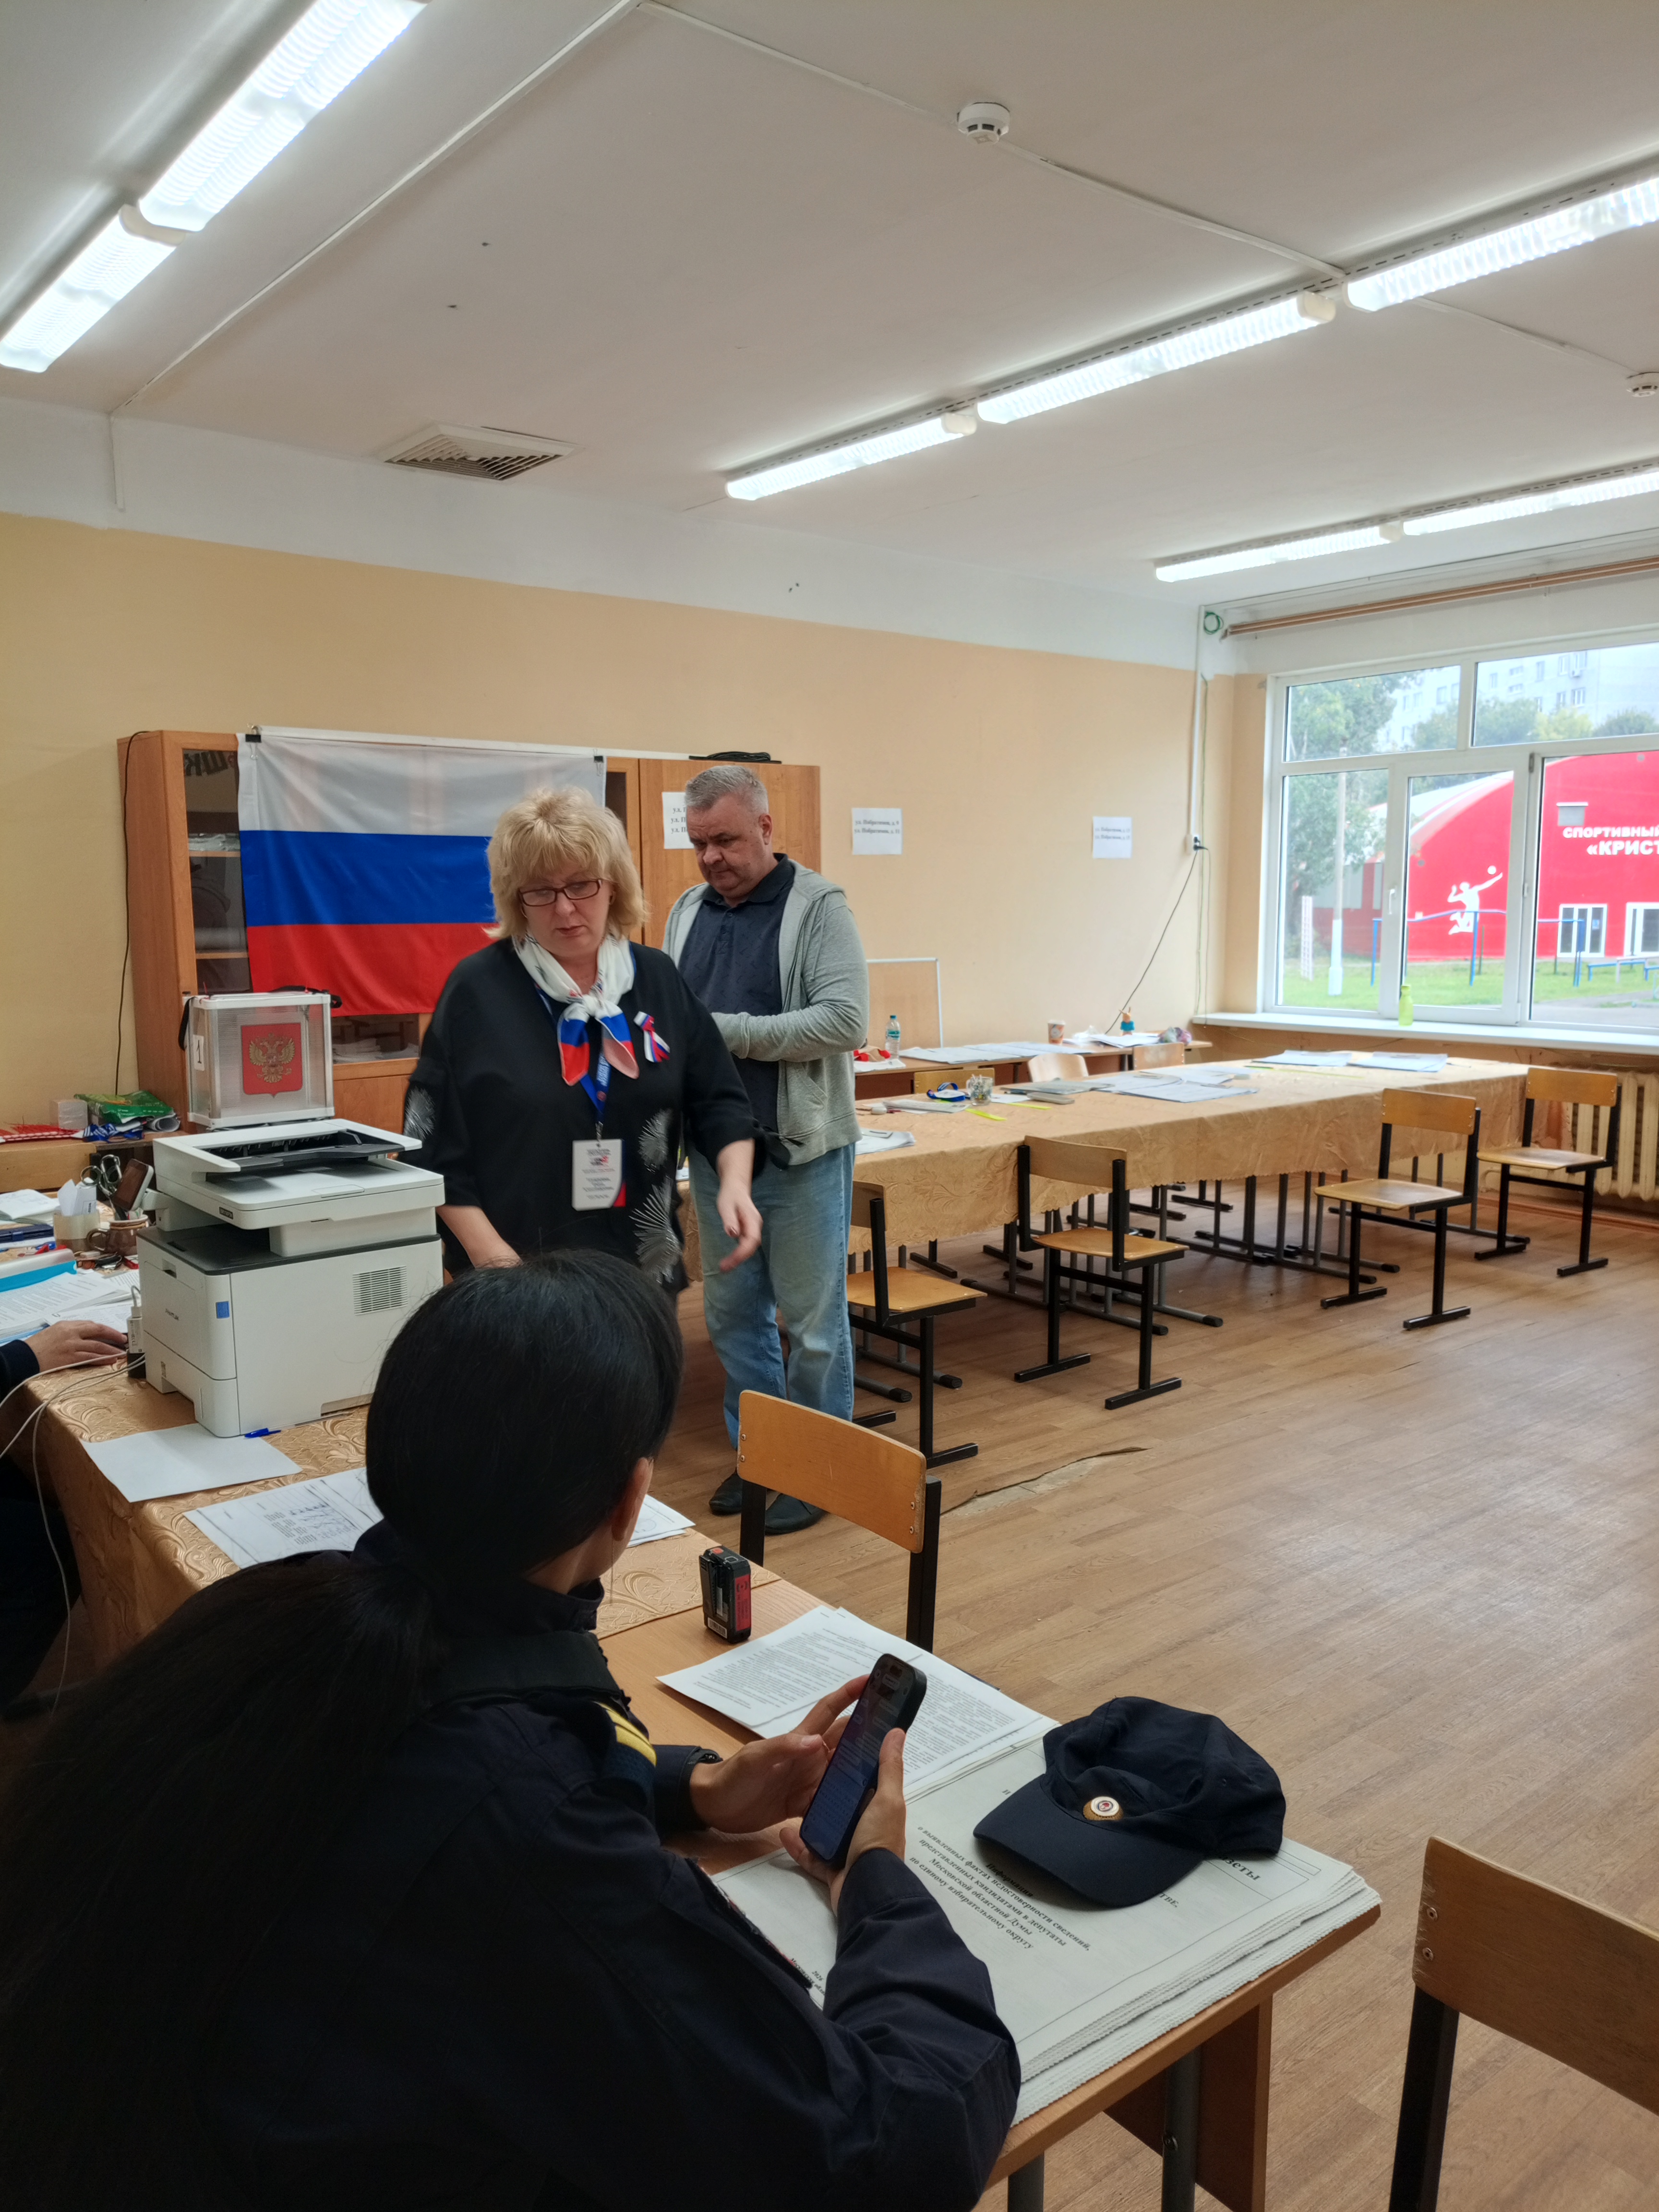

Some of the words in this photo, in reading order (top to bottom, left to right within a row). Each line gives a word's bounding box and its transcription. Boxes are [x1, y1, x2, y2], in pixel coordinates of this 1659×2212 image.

[196, 1040, 202, 1064] 1
[909, 1857, 920, 1865] по
[919, 1863, 949, 1887] единому
[948, 1886, 1007, 1929] избирательному
[1006, 1929, 1034, 1949] округу
[919, 1839, 975, 1881] представленных
[974, 1880, 1023, 1916] кандидатами
[1028, 1919, 1067, 1947] депутаты
[923, 1830, 966, 1862] выявленных
[965, 1860, 992, 1880] фактах
[991, 1879, 1054, 1923] недостоверности
[1053, 1923, 1091, 1951] сведений,
[929, 1858, 973, 1891] Московской
[971, 1890, 1011, 1919] областной
[1008, 1918, 1033, 1936] Думы
